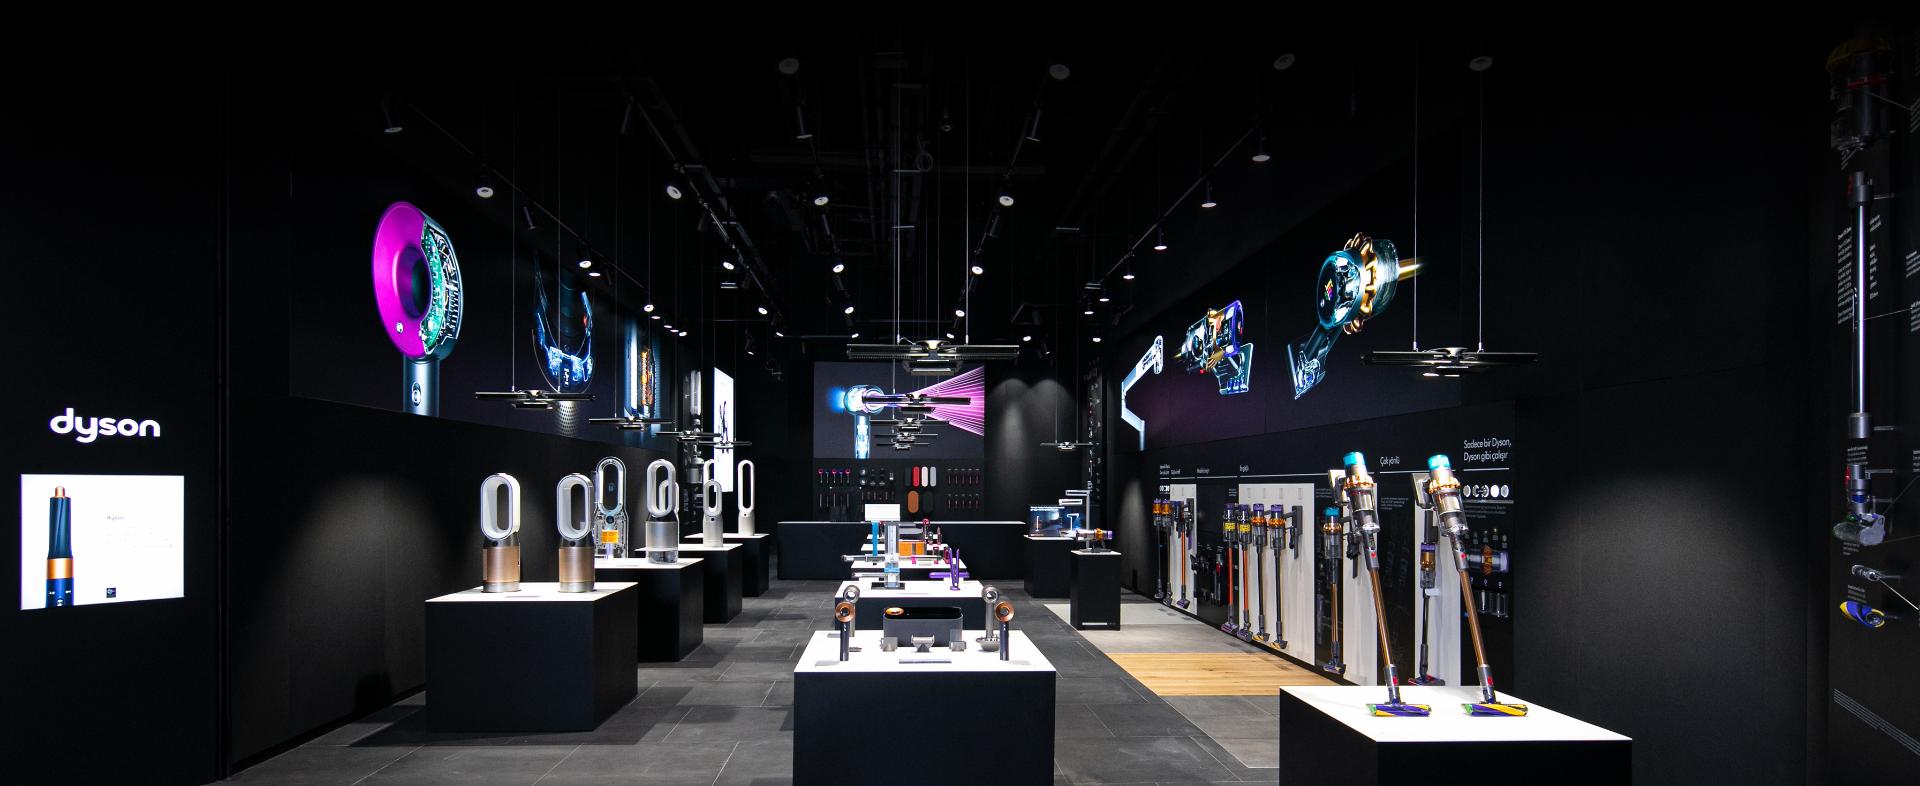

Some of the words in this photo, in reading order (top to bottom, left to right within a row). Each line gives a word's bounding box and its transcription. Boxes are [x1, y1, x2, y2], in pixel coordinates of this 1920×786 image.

[50, 408, 160, 443] dyson
[1464, 440, 1483, 449] Sadece
[1491, 437, 1512, 448] Dyson,
[1463, 452, 1480, 462] Dyson
[1481, 450, 1491, 462] gibi
